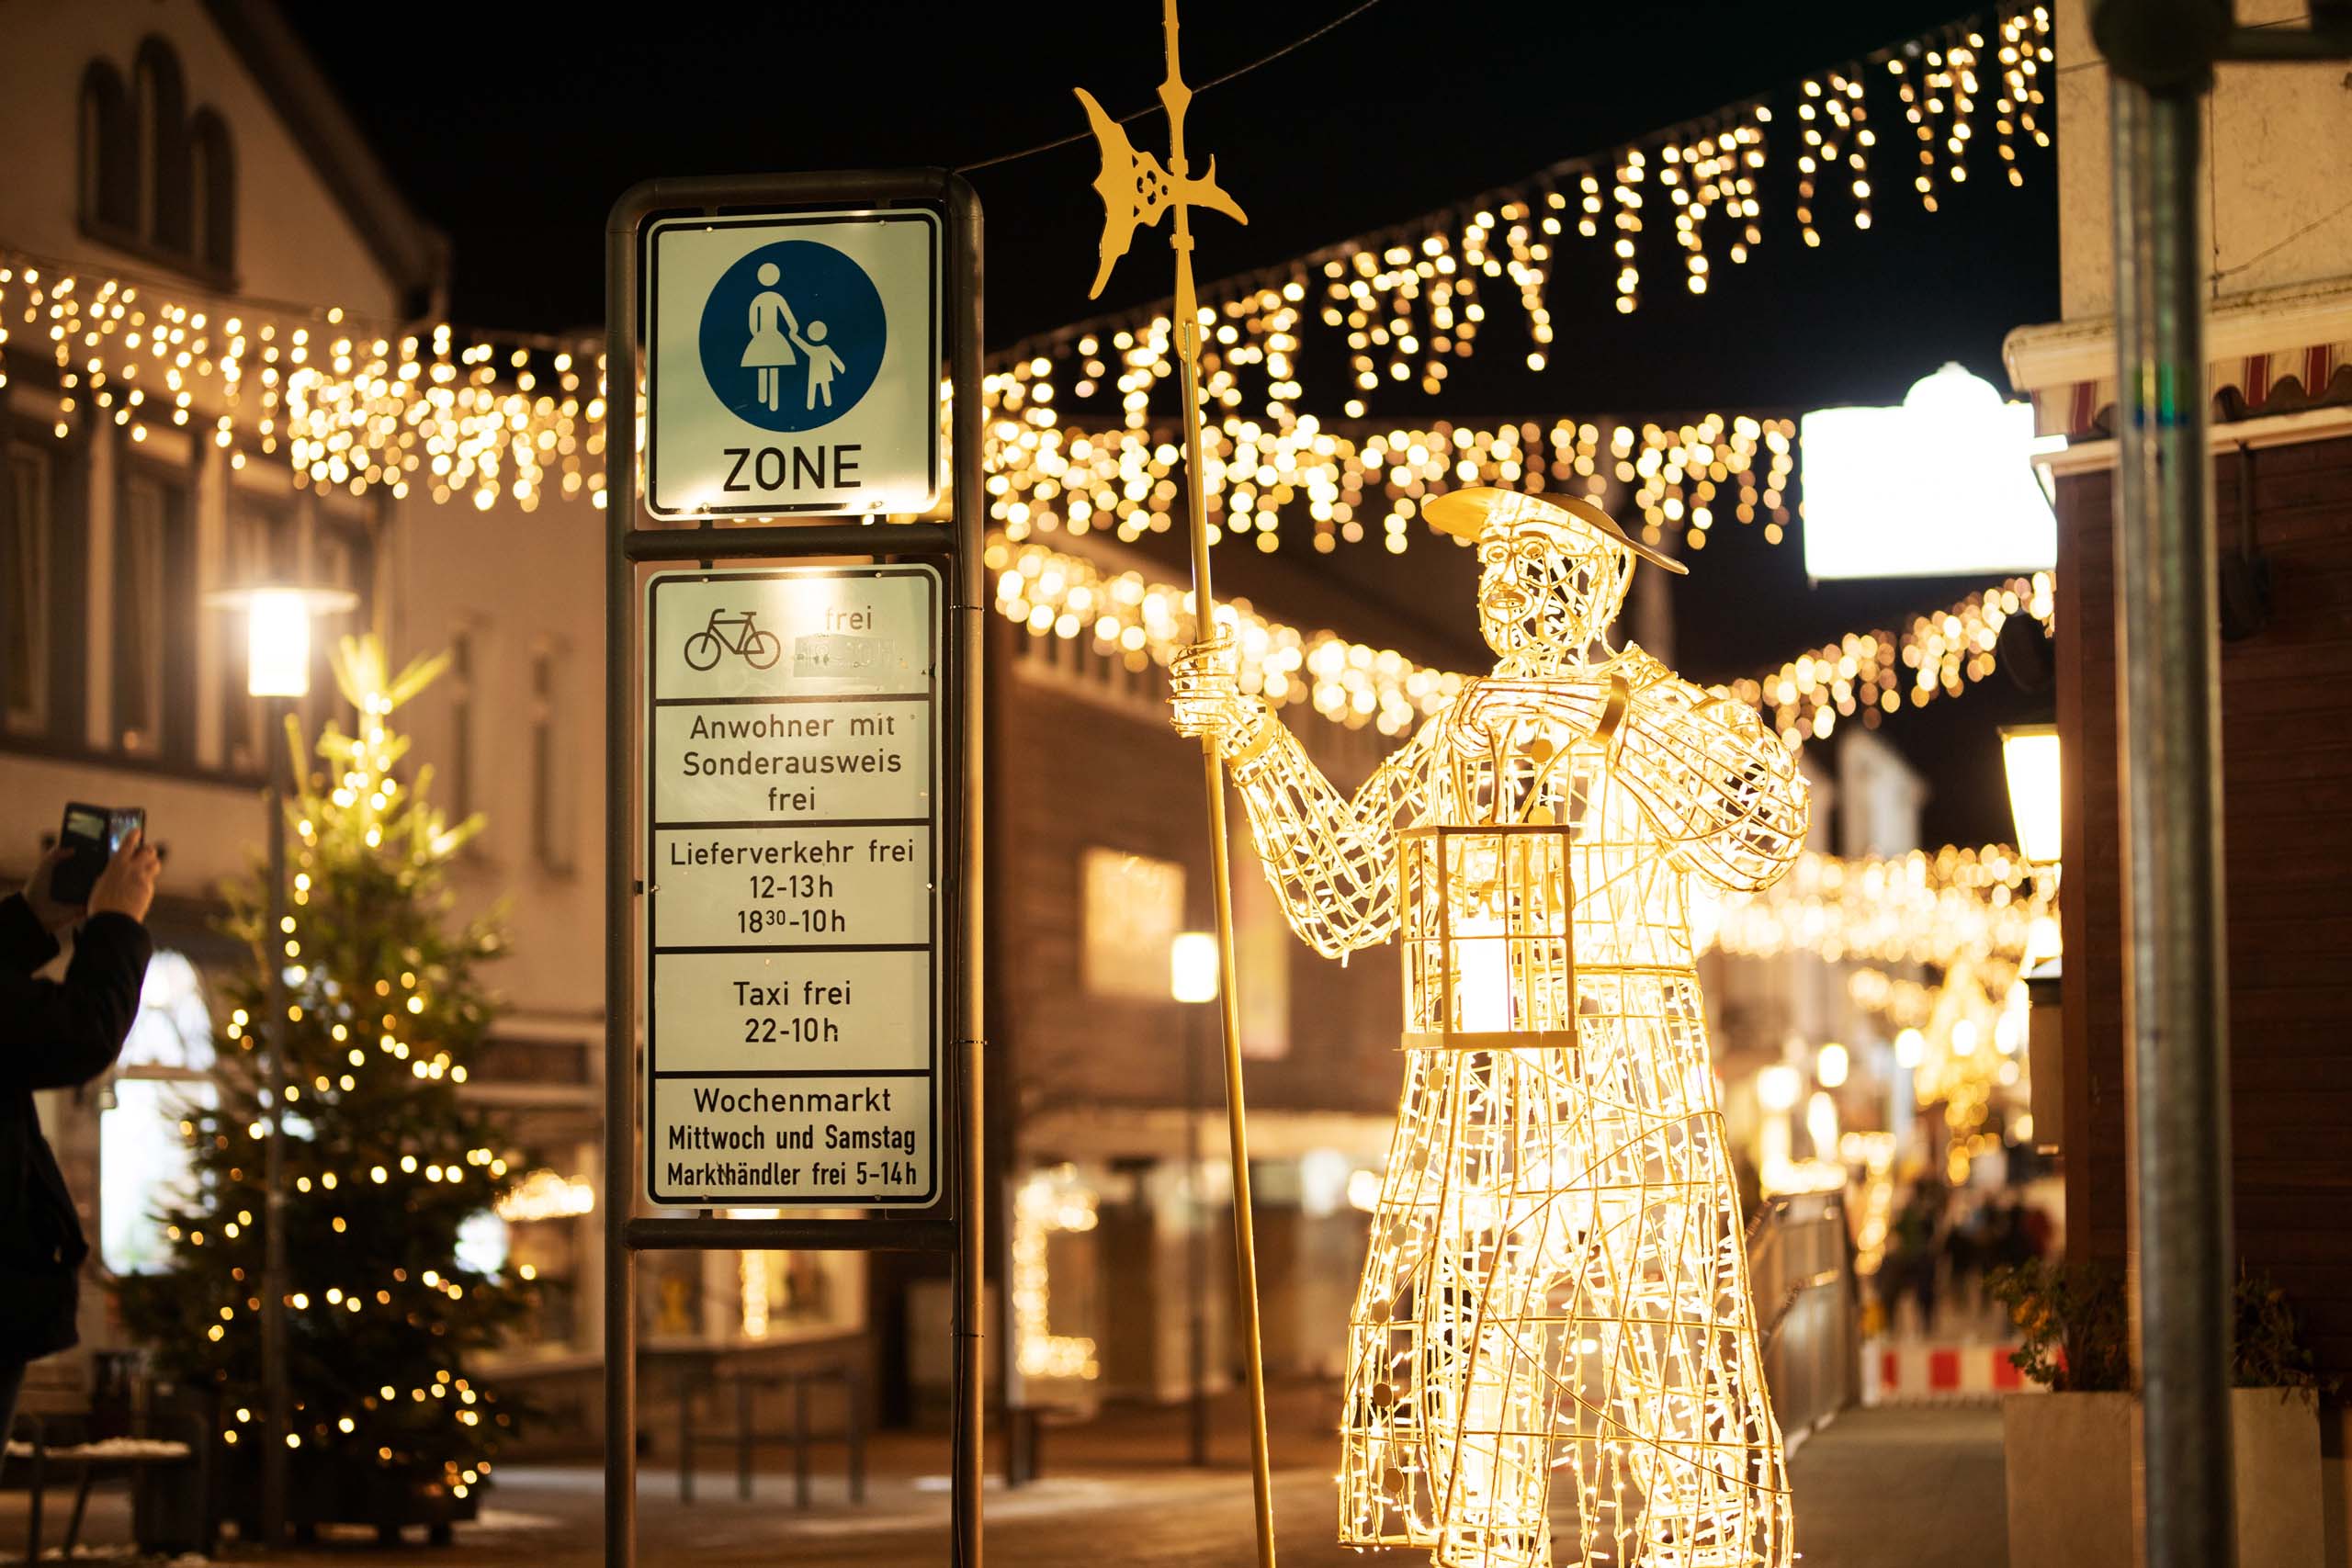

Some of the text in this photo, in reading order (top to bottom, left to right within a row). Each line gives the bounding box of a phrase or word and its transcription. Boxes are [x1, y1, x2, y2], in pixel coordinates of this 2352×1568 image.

[723, 444, 862, 492] ZONE
[825, 605, 873, 632] frei
[689, 712, 895, 739] Anwohner mit
[683, 749, 902, 776] Sonderausweis
[767, 785, 816, 812] frei
[671, 839, 914, 866] Lieferverkehr frei
[733, 980, 851, 1006] Taxi frei
[694, 1087, 891, 1112] Wochenmarkt
[669, 1123, 916, 1155] Mittwoch und Samstag
[667, 1161, 801, 1186] Markthändler
[812, 1161, 846, 1185] frei
